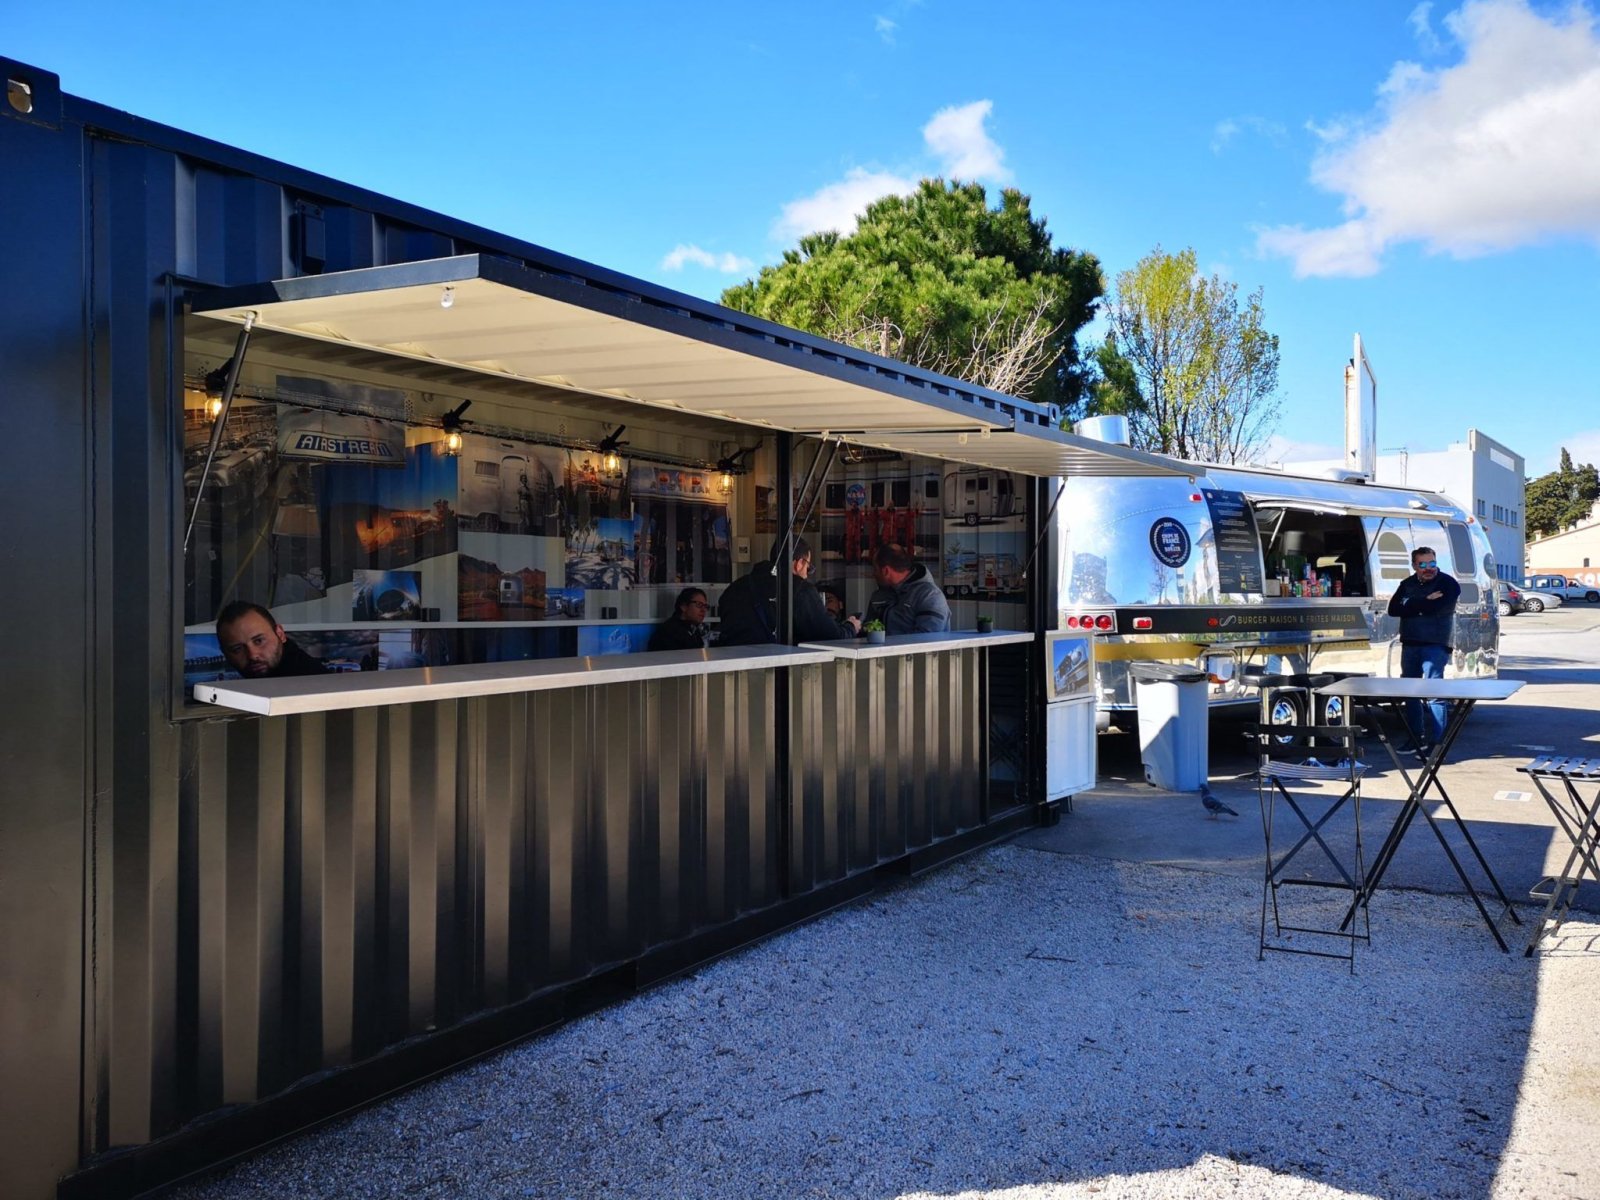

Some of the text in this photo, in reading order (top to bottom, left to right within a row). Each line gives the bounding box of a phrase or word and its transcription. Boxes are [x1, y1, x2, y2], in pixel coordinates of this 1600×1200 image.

[301, 436, 389, 456] AIRSTREAM
[1237, 615, 1268, 625] BURGER
[1270, 615, 1298, 624] MAISON
[1306, 614, 1329, 623] FRITES
[1331, 614, 1357, 623] MAISON
